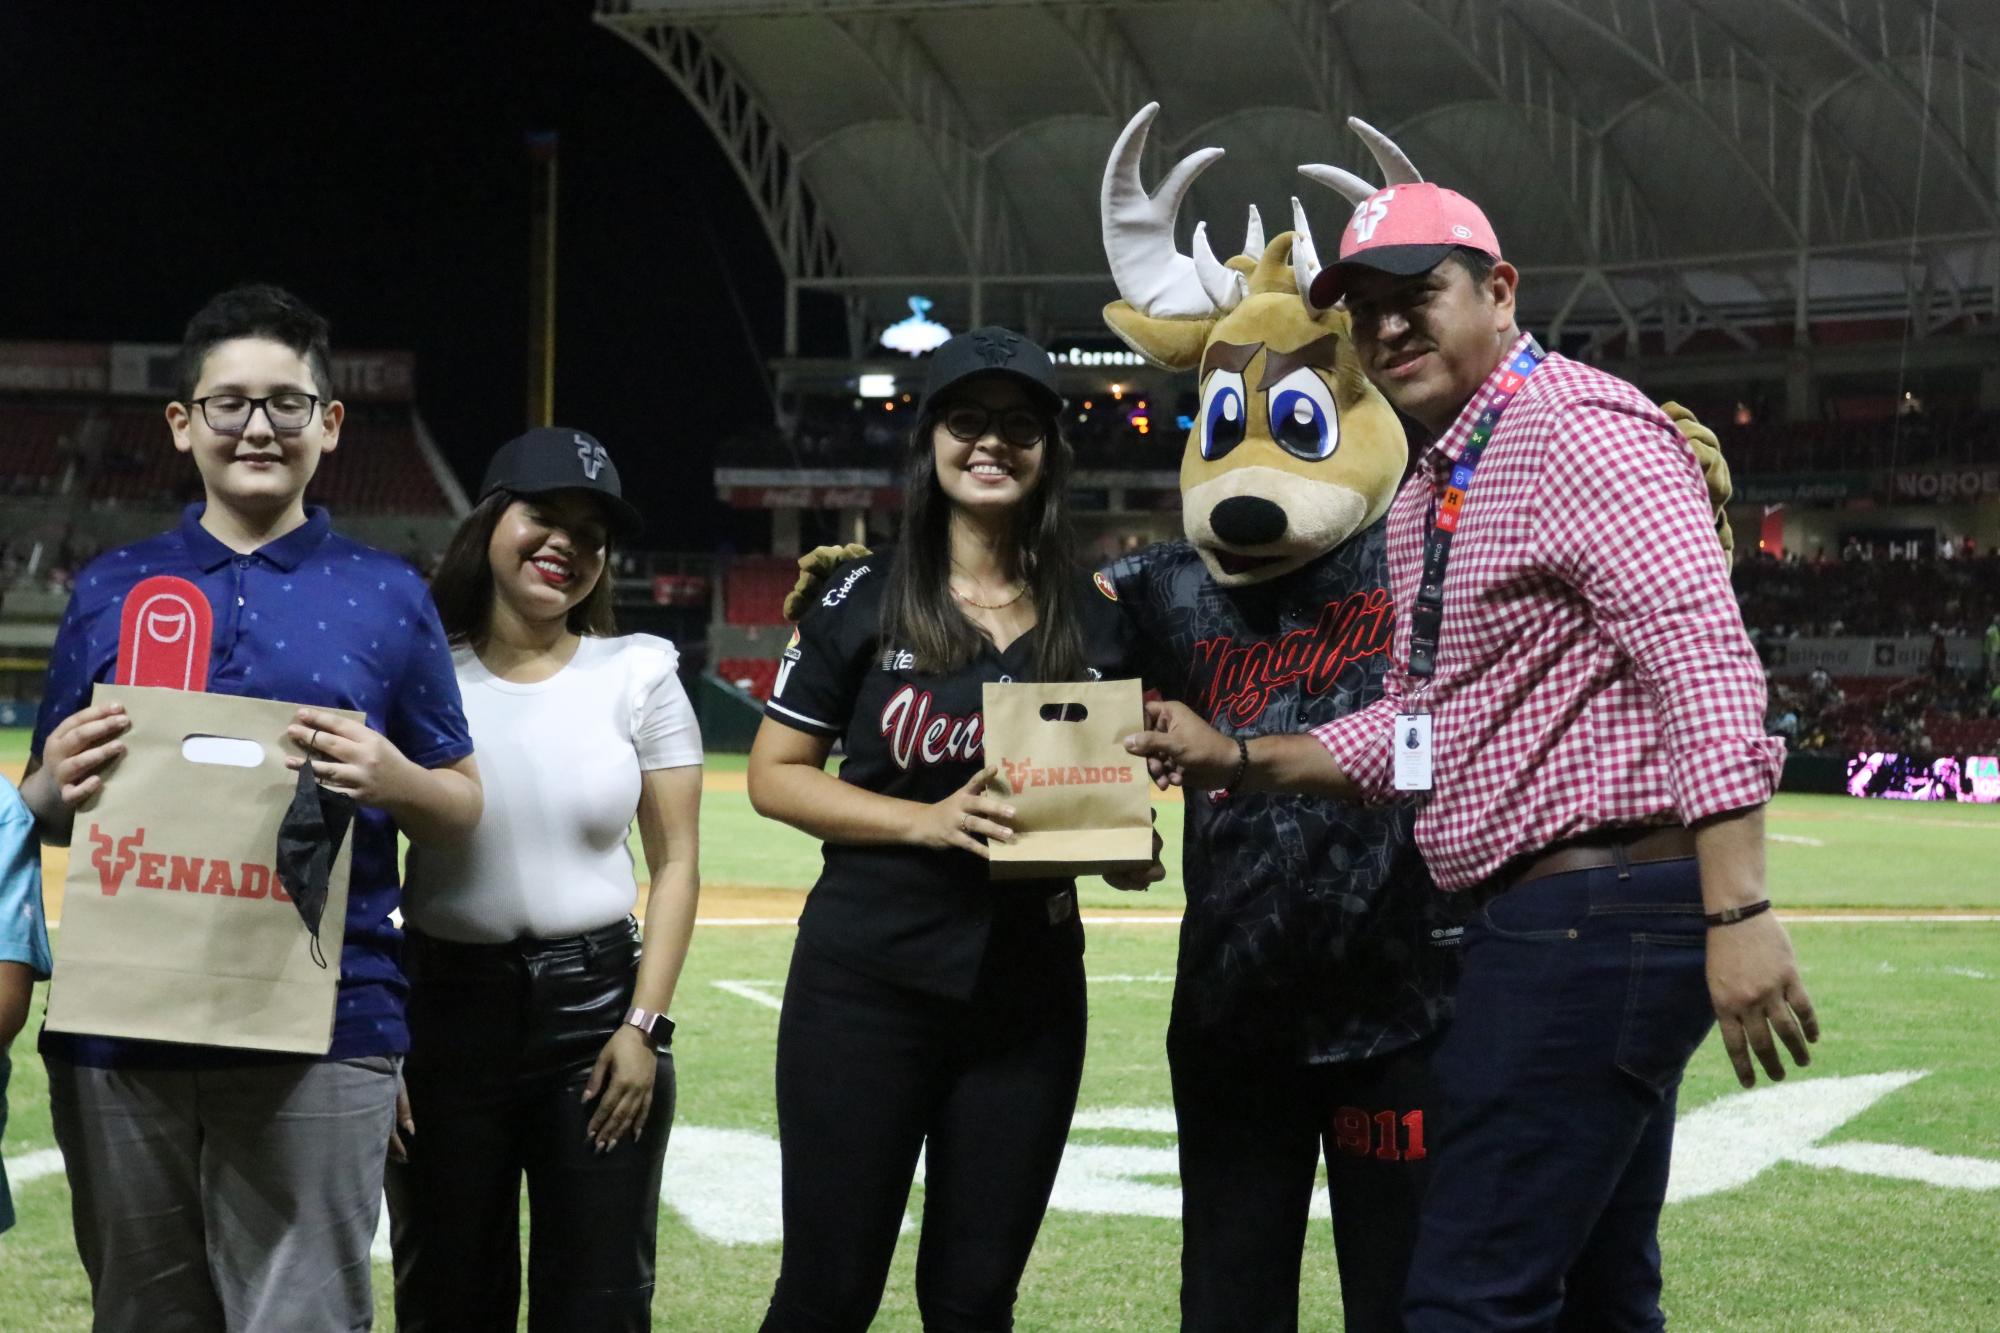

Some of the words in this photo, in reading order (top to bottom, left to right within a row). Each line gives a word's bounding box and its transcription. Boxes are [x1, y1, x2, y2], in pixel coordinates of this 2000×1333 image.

[836, 565, 872, 599] Holcim
[880, 683, 985, 770] Ven
[1001, 757, 1133, 795] VENADOS
[1335, 1106, 1427, 1161] 911
